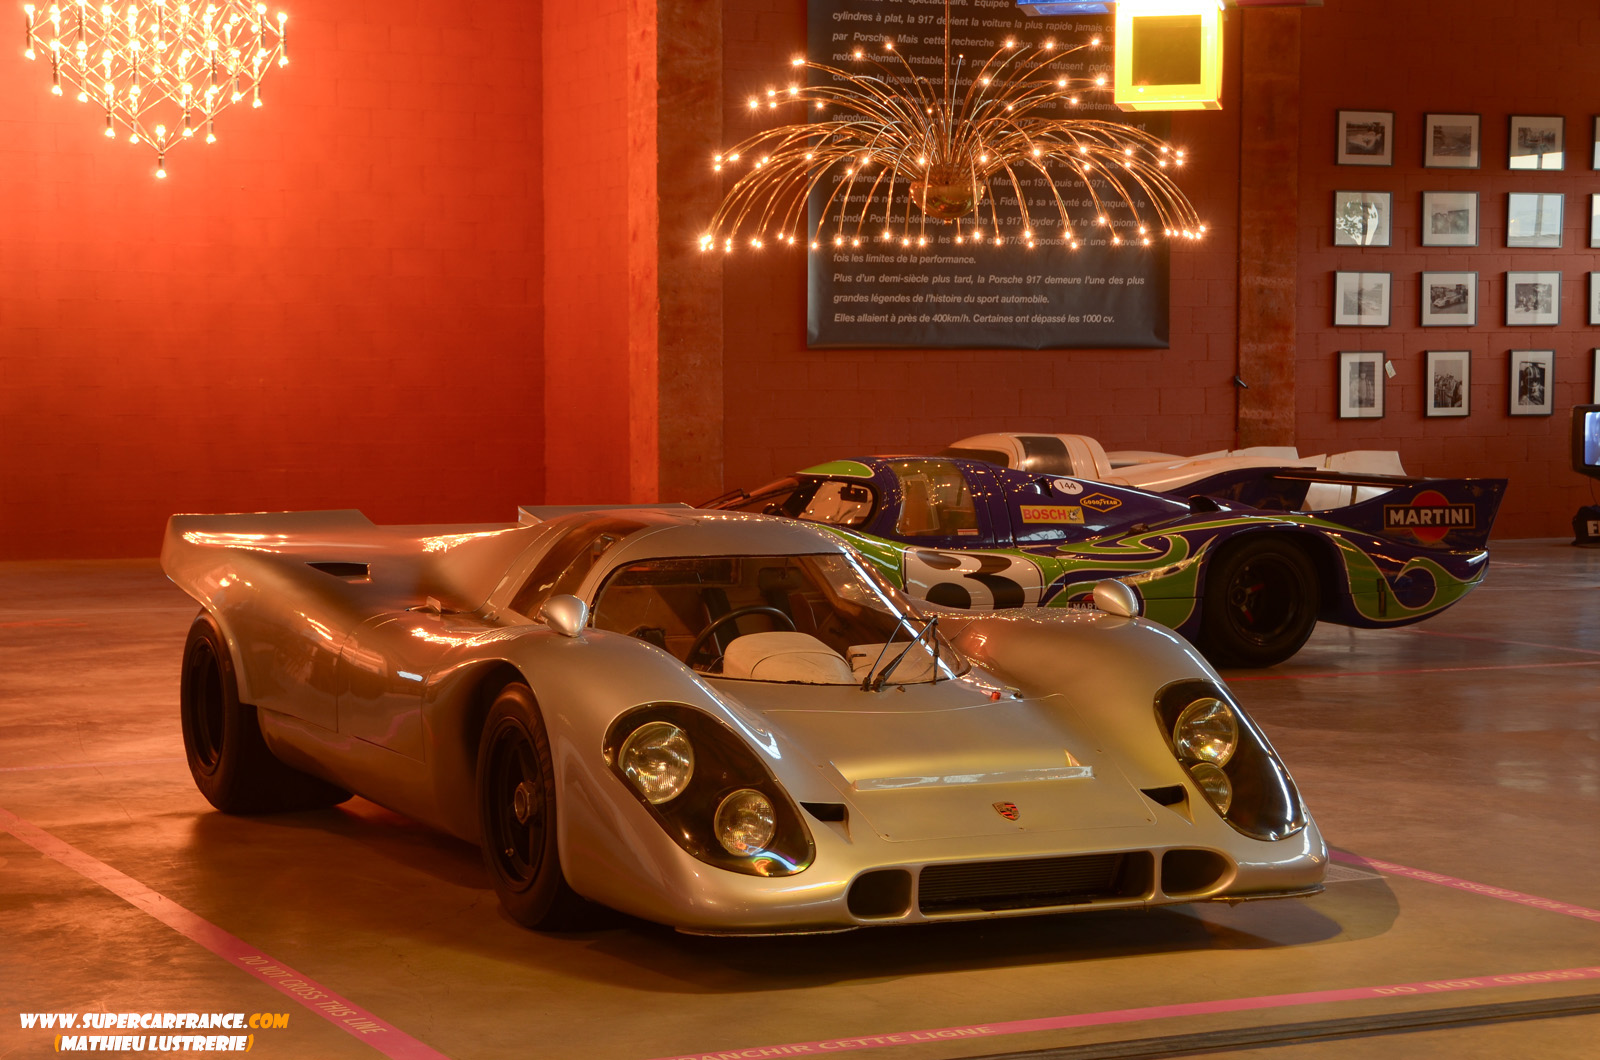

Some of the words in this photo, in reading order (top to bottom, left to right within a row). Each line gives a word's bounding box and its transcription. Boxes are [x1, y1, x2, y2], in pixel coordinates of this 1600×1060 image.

[832, 11, 873, 22] cylindres
[875, 12, 882, 22] à
[884, 12, 904, 25] plat,
[906, 13, 915, 24] la
[918, 14, 934, 25] 917
[971, 17, 979, 27] la
[982, 18, 1012, 28] voiture
[1014, 19, 1022, 29] la
[1025, 20, 1043, 31] plus
[1046, 20, 1073, 32] rapide
[1075, 21, 1103, 33] jamais
[832, 33, 848, 43] par
[897, 34, 919, 45] Mais
[923, 36, 945, 46] cette
[951, 37, 994, 48] recherche
[908, 54, 945, 66] instable.
[1048, 60, 1084, 71] refusent
[1020, 179, 1031, 187] en
[1054, 178, 1072, 189] puis
[1073, 179, 1084, 189] en
[1028, 197, 1034, 208] à
[1035, 199, 1046, 208] sa
[1081, 198, 1093, 209] de
[1136, 198, 1146, 209] le
[1006, 216, 1022, 226] 917
[1079, 217, 1088, 227] le
[938, 235, 951, 244] les
[1090, 238, 1106, 247] une
[833, 253, 849, 263] fois
[851, 253, 864, 263] les
[866, 253, 895, 264] limites
[896, 254, 908, 264] de
[909, 254, 918, 264] la
[919, 255, 977, 265] performance.
[833, 273, 852, 283] Plus
[855, 274, 876, 283] d'un
[878, 273, 929, 283] demi-siècle
[931, 274, 951, 285] plus
[954, 275, 974, 285] tard,
[977, 275, 985, 284] la
[988, 275, 1023, 284] Porsche
[1026, 275, 1042, 284] 917
[1044, 275, 1082, 285] demeure
[1084, 275, 1105, 285] l'une
[1108, 276, 1124, 285] des
[1126, 276, 1145, 286] plus
[833, 294, 869, 304] grandes
[871, 293, 911, 304] légendes
[912, 294, 924, 303] de
[925, 294, 962, 303] l'histoire
[963, 294, 975, 303] du
[976, 295, 999, 305] sport
[1001, 295, 1050, 304] automobile.
[834, 313, 856, 323] Elles
[857, 313, 889, 323] allaient
[890, 314, 897, 323] à
[898, 314, 917, 324] près
[919, 314, 931, 323] de
[932, 314, 971, 323] 400km/h.
[973, 314, 1014, 323] Certaines
[1015, 314, 1030, 323] ont
[1031, 314, 1066, 325] dépassé
[1067, 314, 1080, 323] les
[1082, 315, 1102, 324] 1000
[1103, 316, 1114, 324] cv.
[1058, 481, 1077, 490] 144
[1022, 508, 1067, 521] BOSCH
[1389, 508, 1470, 525] MARTINI
[916, 550, 1026, 610] 3
[1073, 602, 1099, 611] MART
[1371, 985, 1418, 996] DO
[1423, 979, 1484, 991] NOT
[1492, 971, 1585, 984] CROSS
[238, 955, 269, 966] DO
[255, 965, 293, 979] NOT
[278, 979, 329, 1000] CROSS
[315, 1000, 357, 1017] THIS
[342, 1017, 387, 1034] LINE
[818, 1035, 907, 1050] CETTE
[909, 1026, 997, 1041] LIGNE
